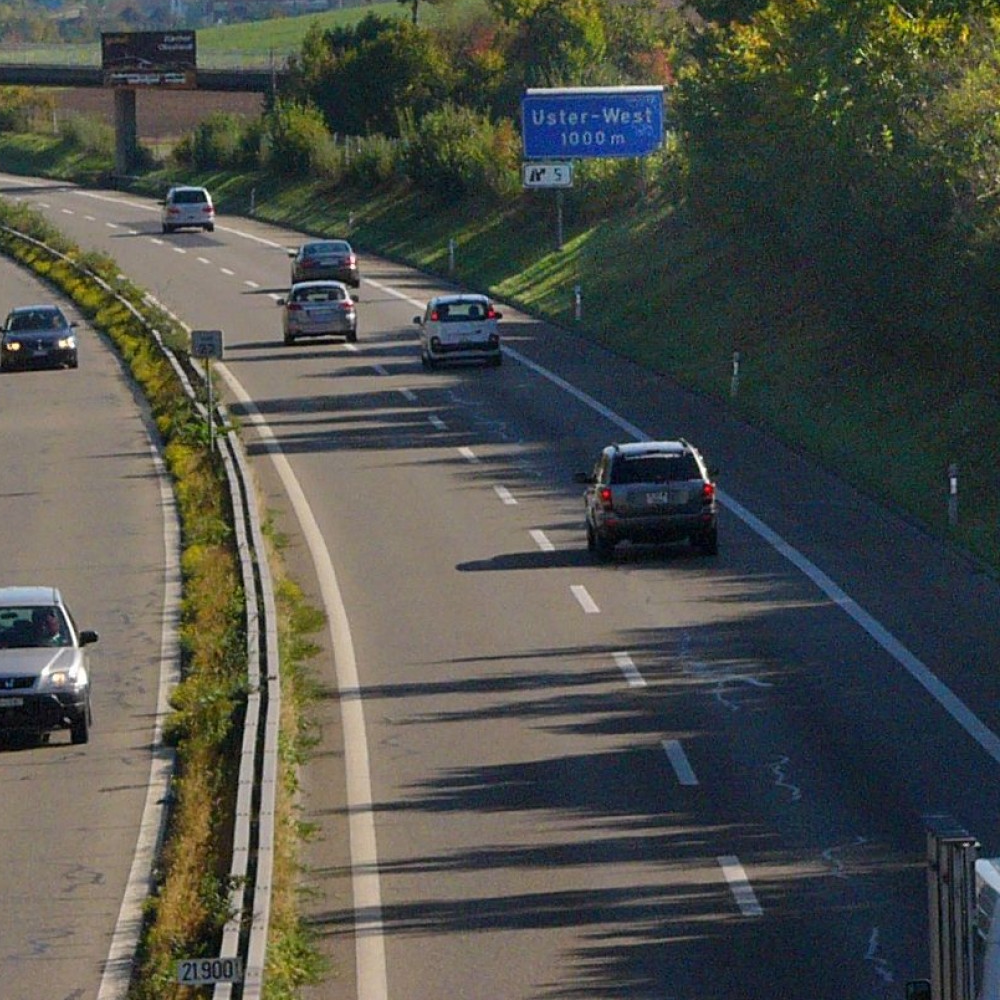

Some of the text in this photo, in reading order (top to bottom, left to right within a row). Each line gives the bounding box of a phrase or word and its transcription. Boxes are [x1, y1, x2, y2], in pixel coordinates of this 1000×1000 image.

[532, 107, 653, 125] Uster-West
[561, 131, 625, 146] 1000 m
